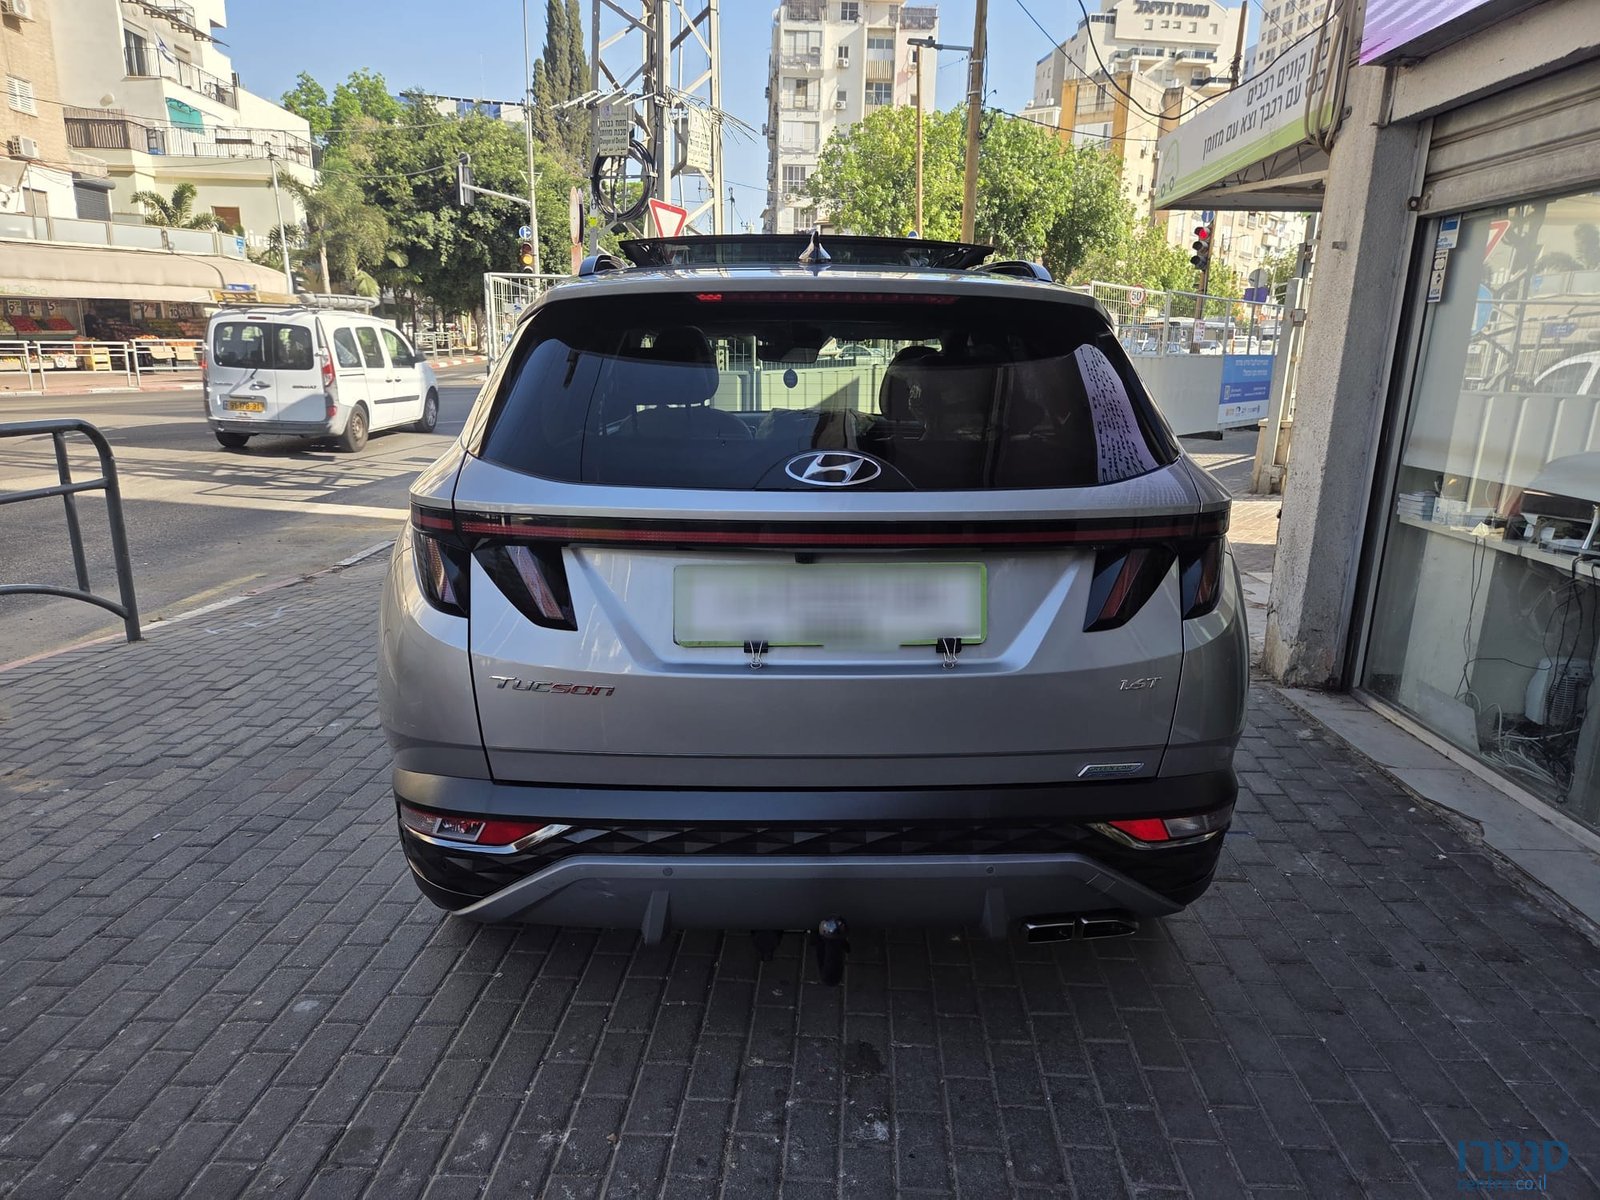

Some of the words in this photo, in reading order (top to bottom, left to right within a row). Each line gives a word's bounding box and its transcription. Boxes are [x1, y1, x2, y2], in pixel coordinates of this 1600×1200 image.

[1276, 52, 1307, 88] קונים
[1246, 74, 1275, 107] רכבים
[1285, 82, 1302, 110] עם
[1240, 109, 1257, 135] וצא
[1260, 94, 1283, 130] רכבך
[1203, 129, 1224, 160] מזומן
[1225, 120, 1238, 142] עם
[1131, 290, 1142, 301] 50
